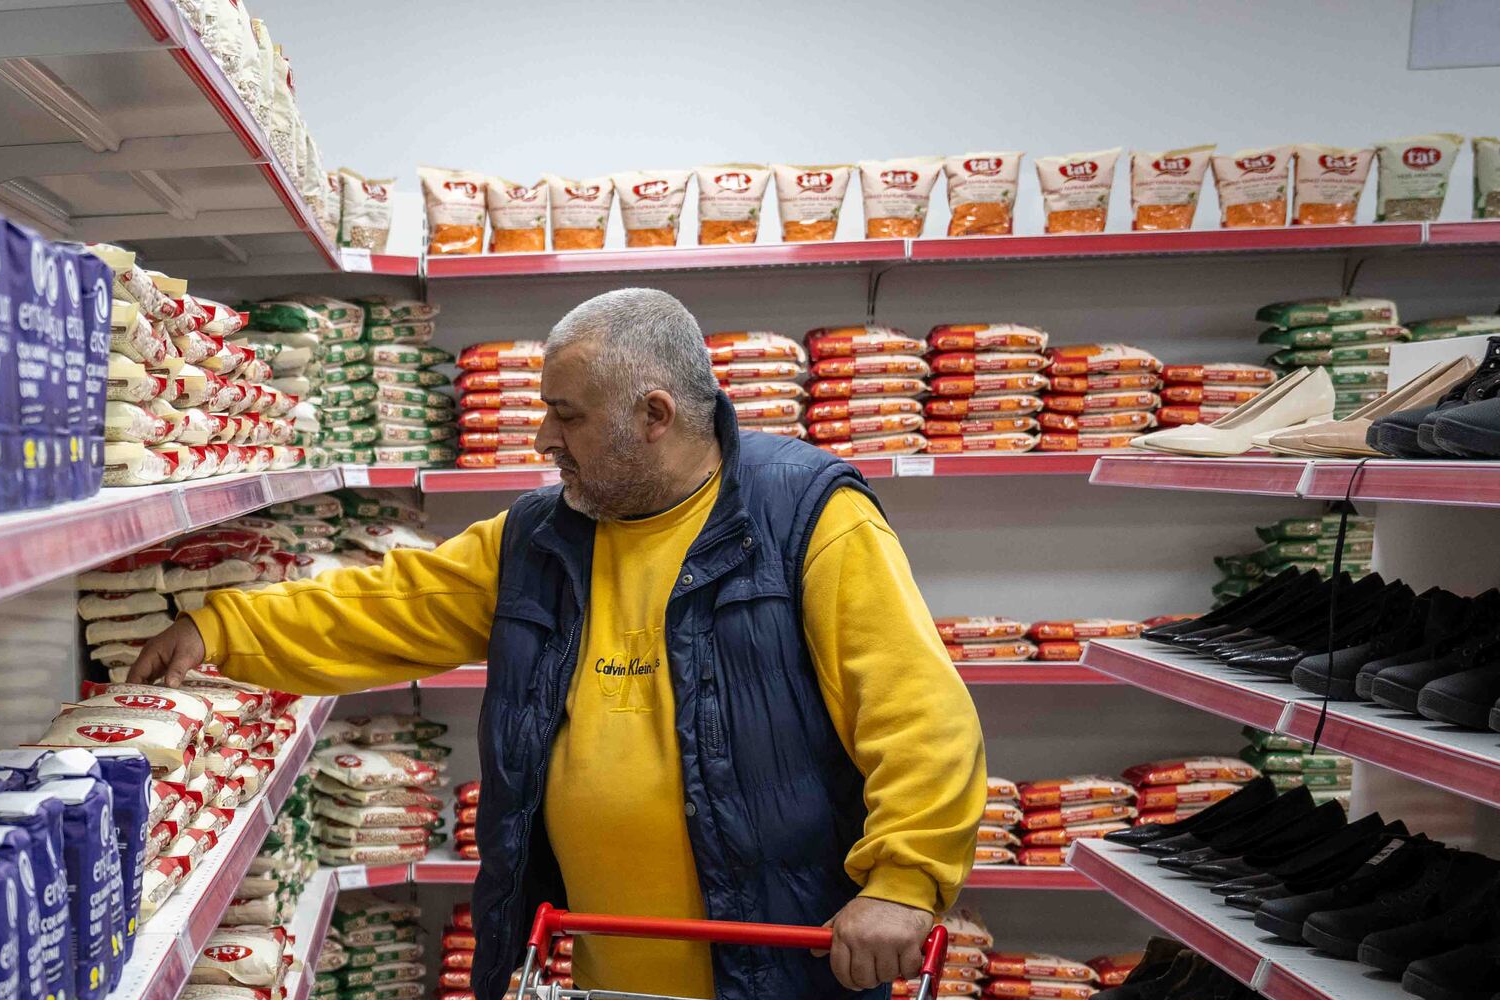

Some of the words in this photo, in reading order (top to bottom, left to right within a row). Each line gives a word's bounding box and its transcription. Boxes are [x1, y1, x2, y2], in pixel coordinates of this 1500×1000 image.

[1244, 157, 1270, 168] tat
[1408, 150, 1436, 163] tat
[970, 159, 999, 171] tat
[1065, 163, 1094, 176] tat
[1160, 159, 1185, 170] tat
[802, 173, 828, 187] tat
[595, 657, 626, 676] Calvin
[119, 694, 170, 710] tat
[84, 724, 136, 737] tat
[209, 946, 247, 960] tat
